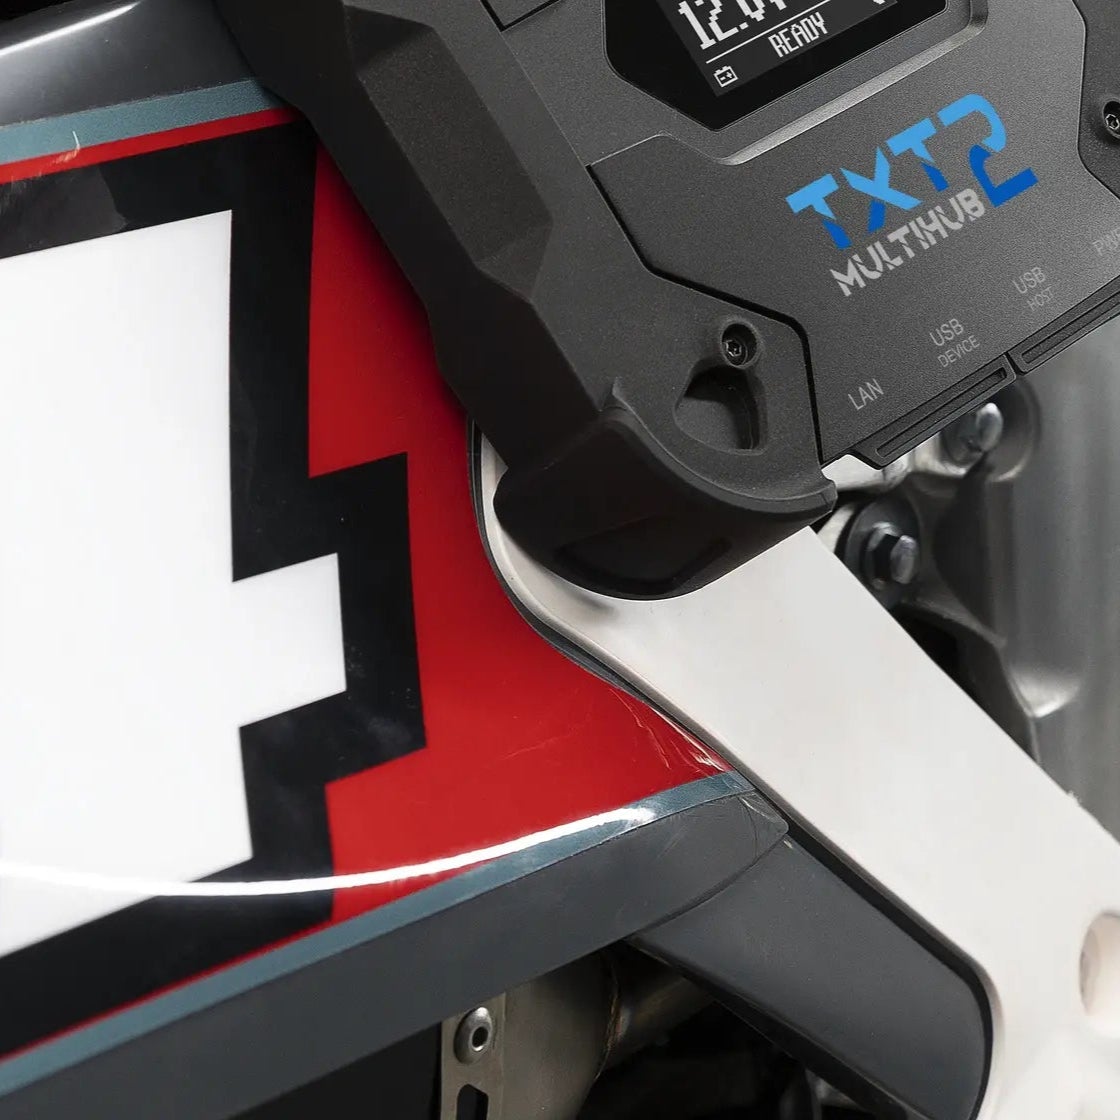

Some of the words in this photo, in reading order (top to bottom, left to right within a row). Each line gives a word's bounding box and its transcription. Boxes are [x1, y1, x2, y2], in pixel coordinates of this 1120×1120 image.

[768, 12, 829, 58] READY
[829, 187, 986, 296] MULTIHUB
[1012, 267, 1045, 294] USB
[1027, 285, 1053, 312] HOST
[929, 318, 964, 346] USB
[937, 334, 981, 367] DEVICE
[848, 378, 884, 410] LAN
